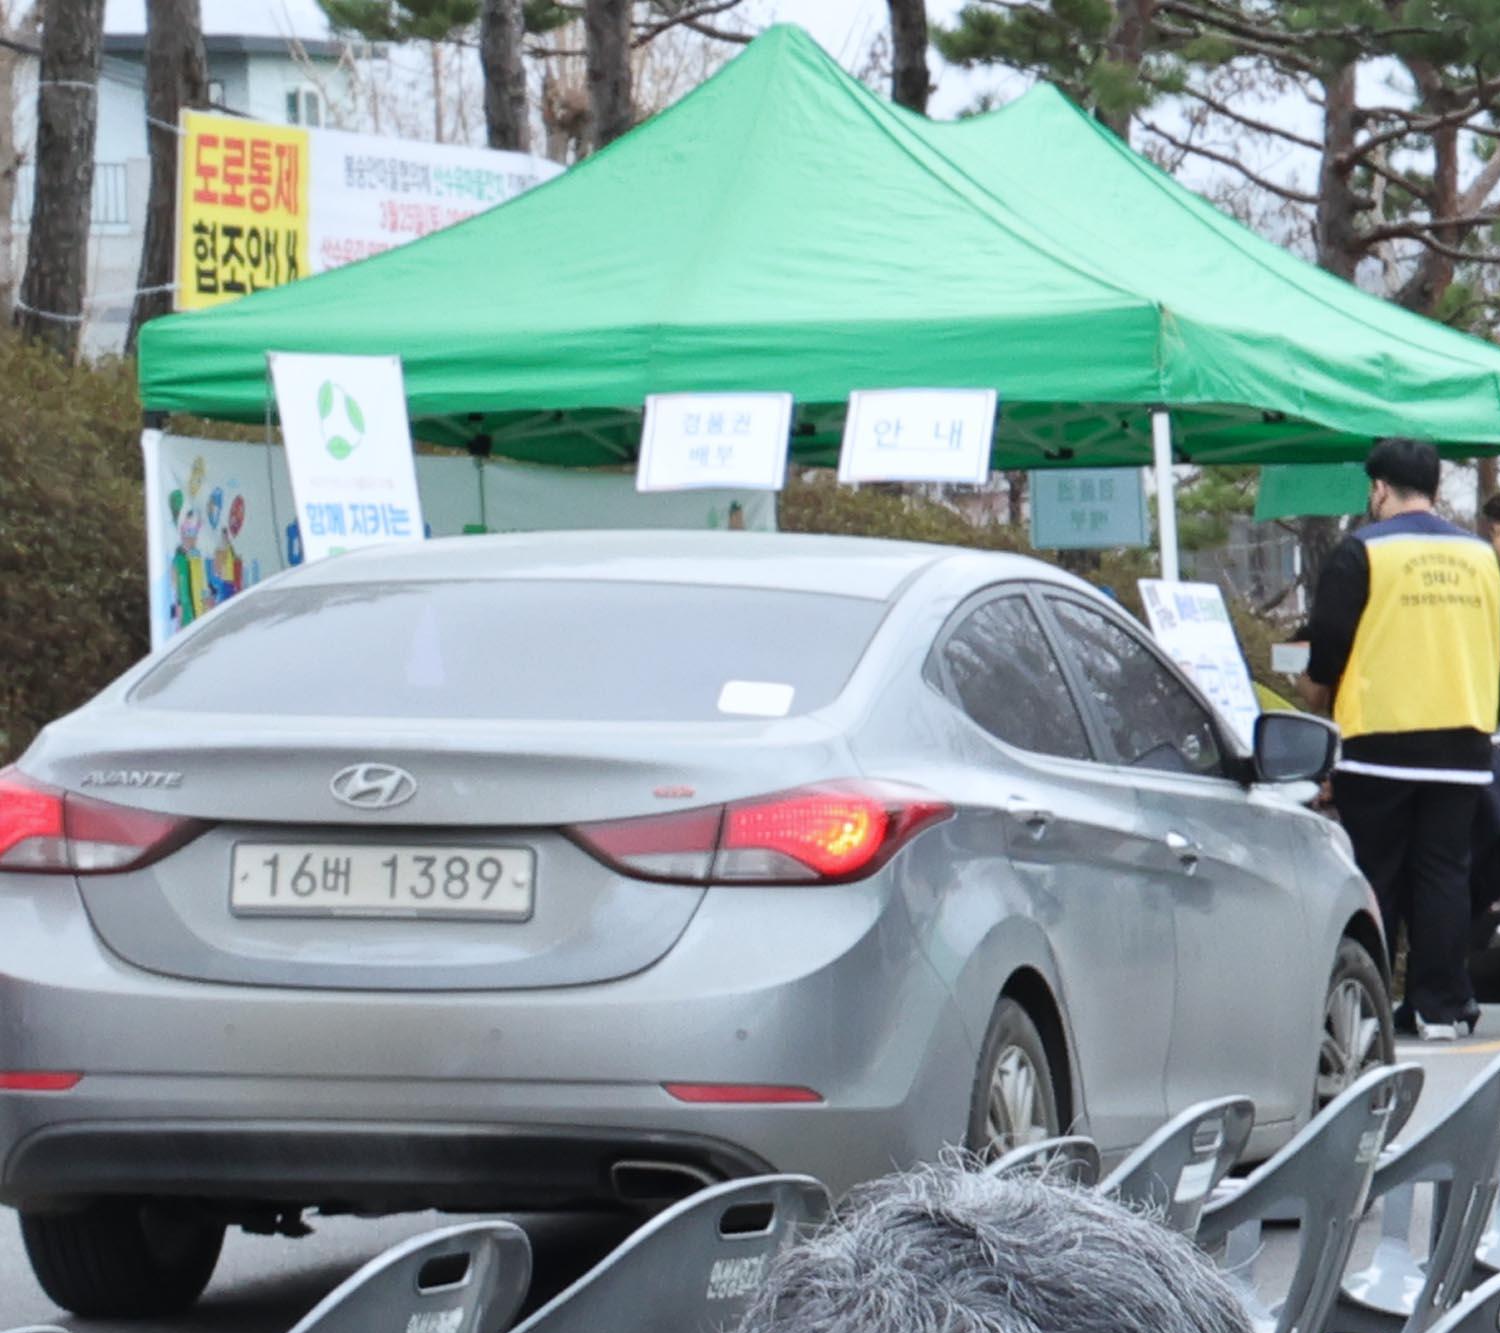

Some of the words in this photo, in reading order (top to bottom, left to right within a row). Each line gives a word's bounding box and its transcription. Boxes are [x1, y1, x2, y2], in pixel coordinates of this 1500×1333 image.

[193, 132, 300, 217] 도로통제
[192, 217, 300, 295] 협조안내
[305, 502, 347, 536] 함께
[349, 502, 412, 536] 지키는
[81, 769, 185, 788] AVANTE
[262, 853, 351, 897] 16버
[381, 853, 504, 901] 1389
